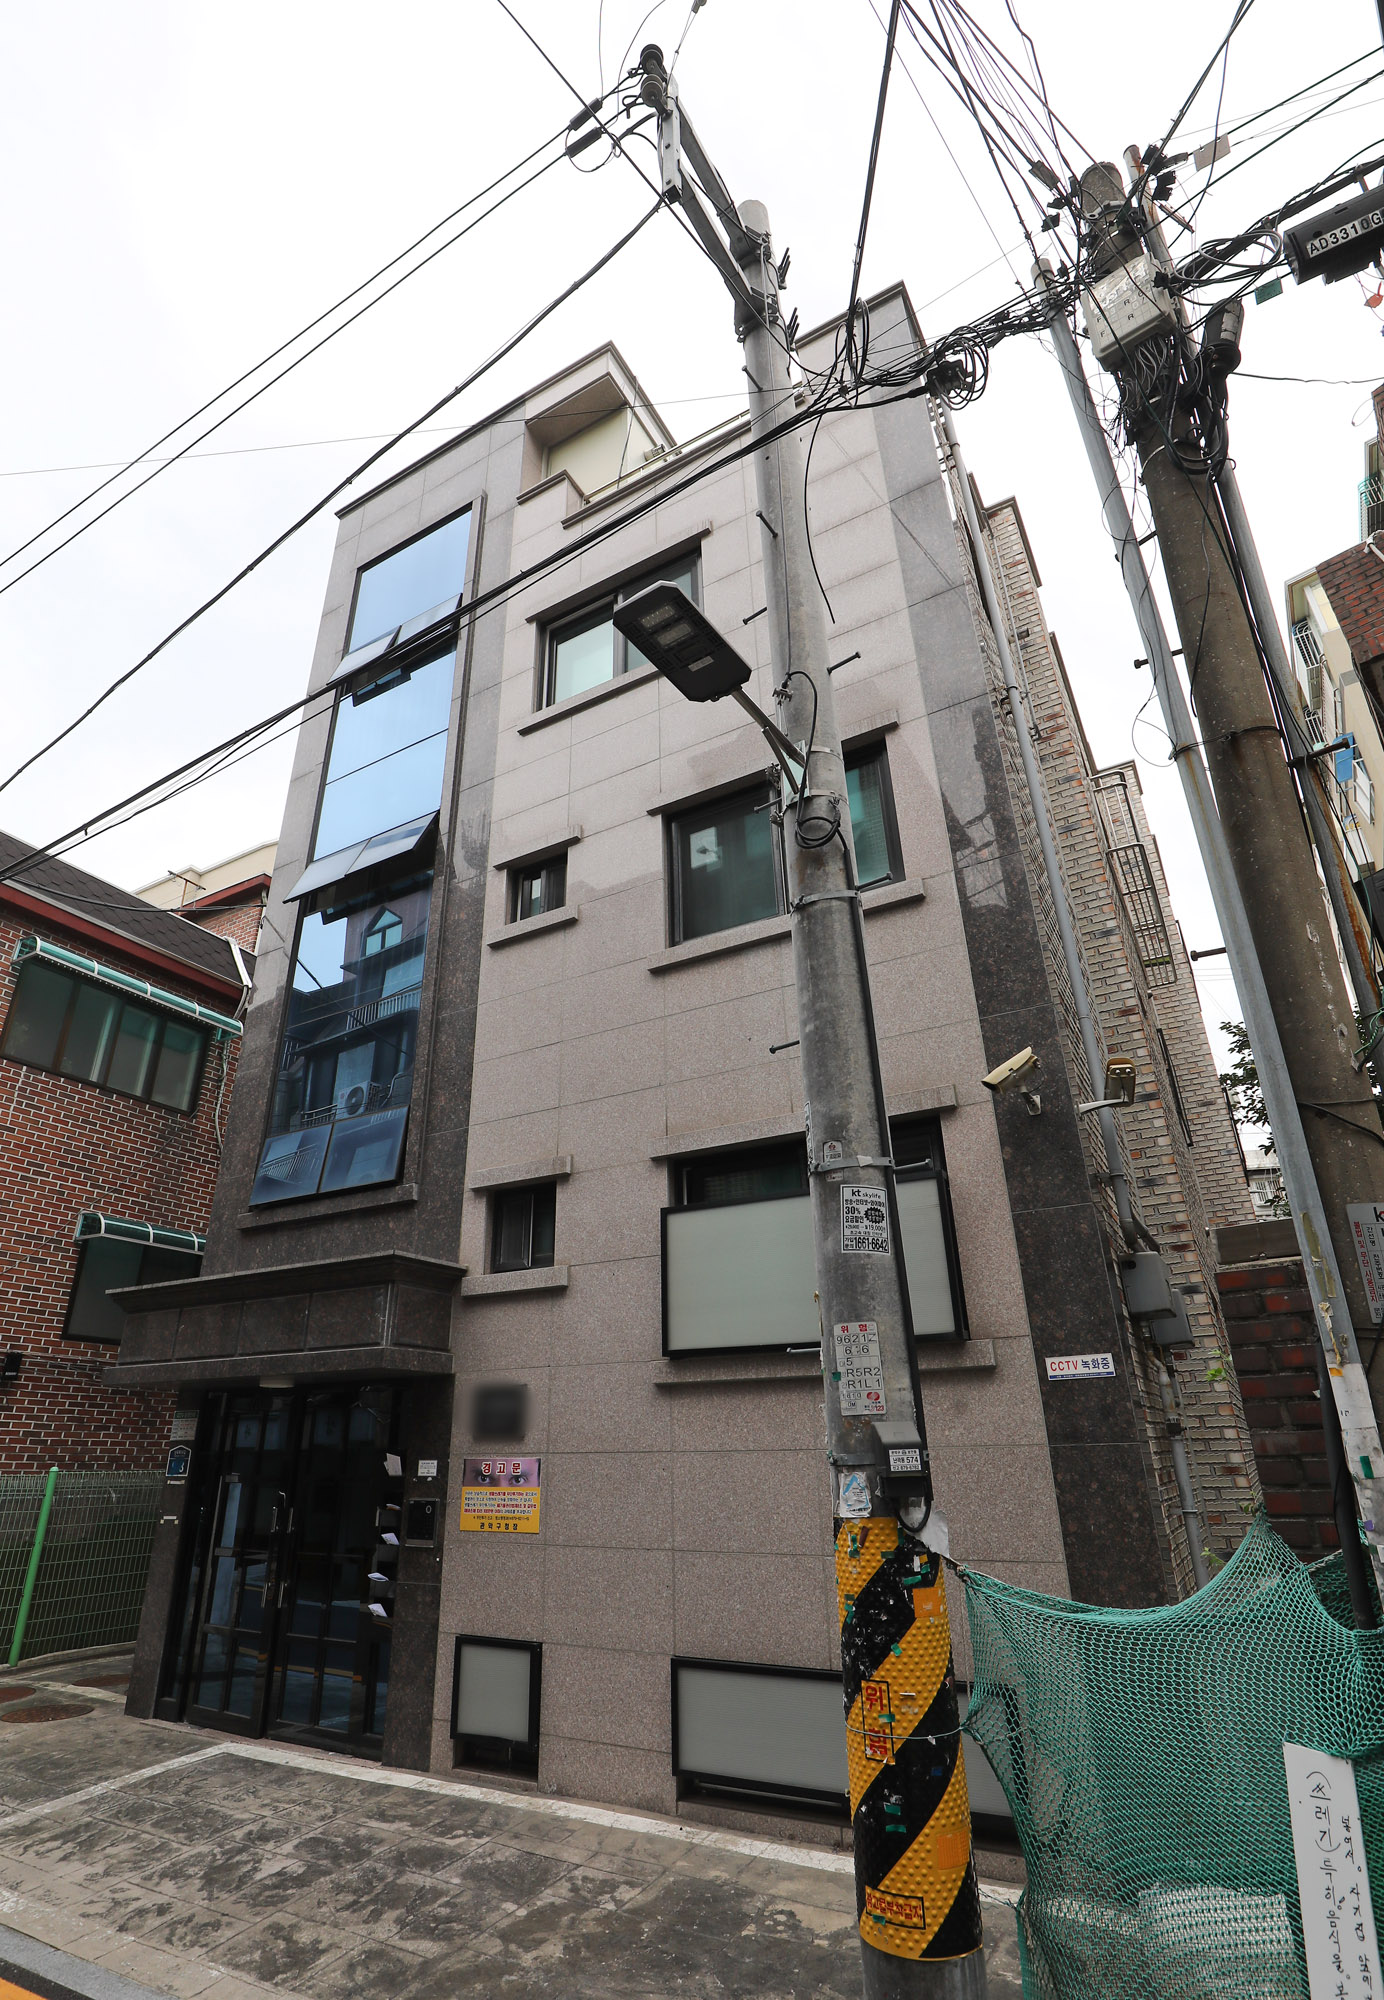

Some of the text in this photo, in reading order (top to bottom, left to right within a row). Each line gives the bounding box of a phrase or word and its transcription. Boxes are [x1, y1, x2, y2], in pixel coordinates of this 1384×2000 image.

[1309, 212, 1382, 255] AD3310G
[851, 1189, 862, 1197] kt
[845, 1206, 861, 1215] 30%
[836, 1332, 877, 1345] 9621Z
[1050, 1357, 1110, 1371] CCTV 녹화중
[906, 1456, 919, 1464] 574
[482, 1462, 521, 1475] 경고문
